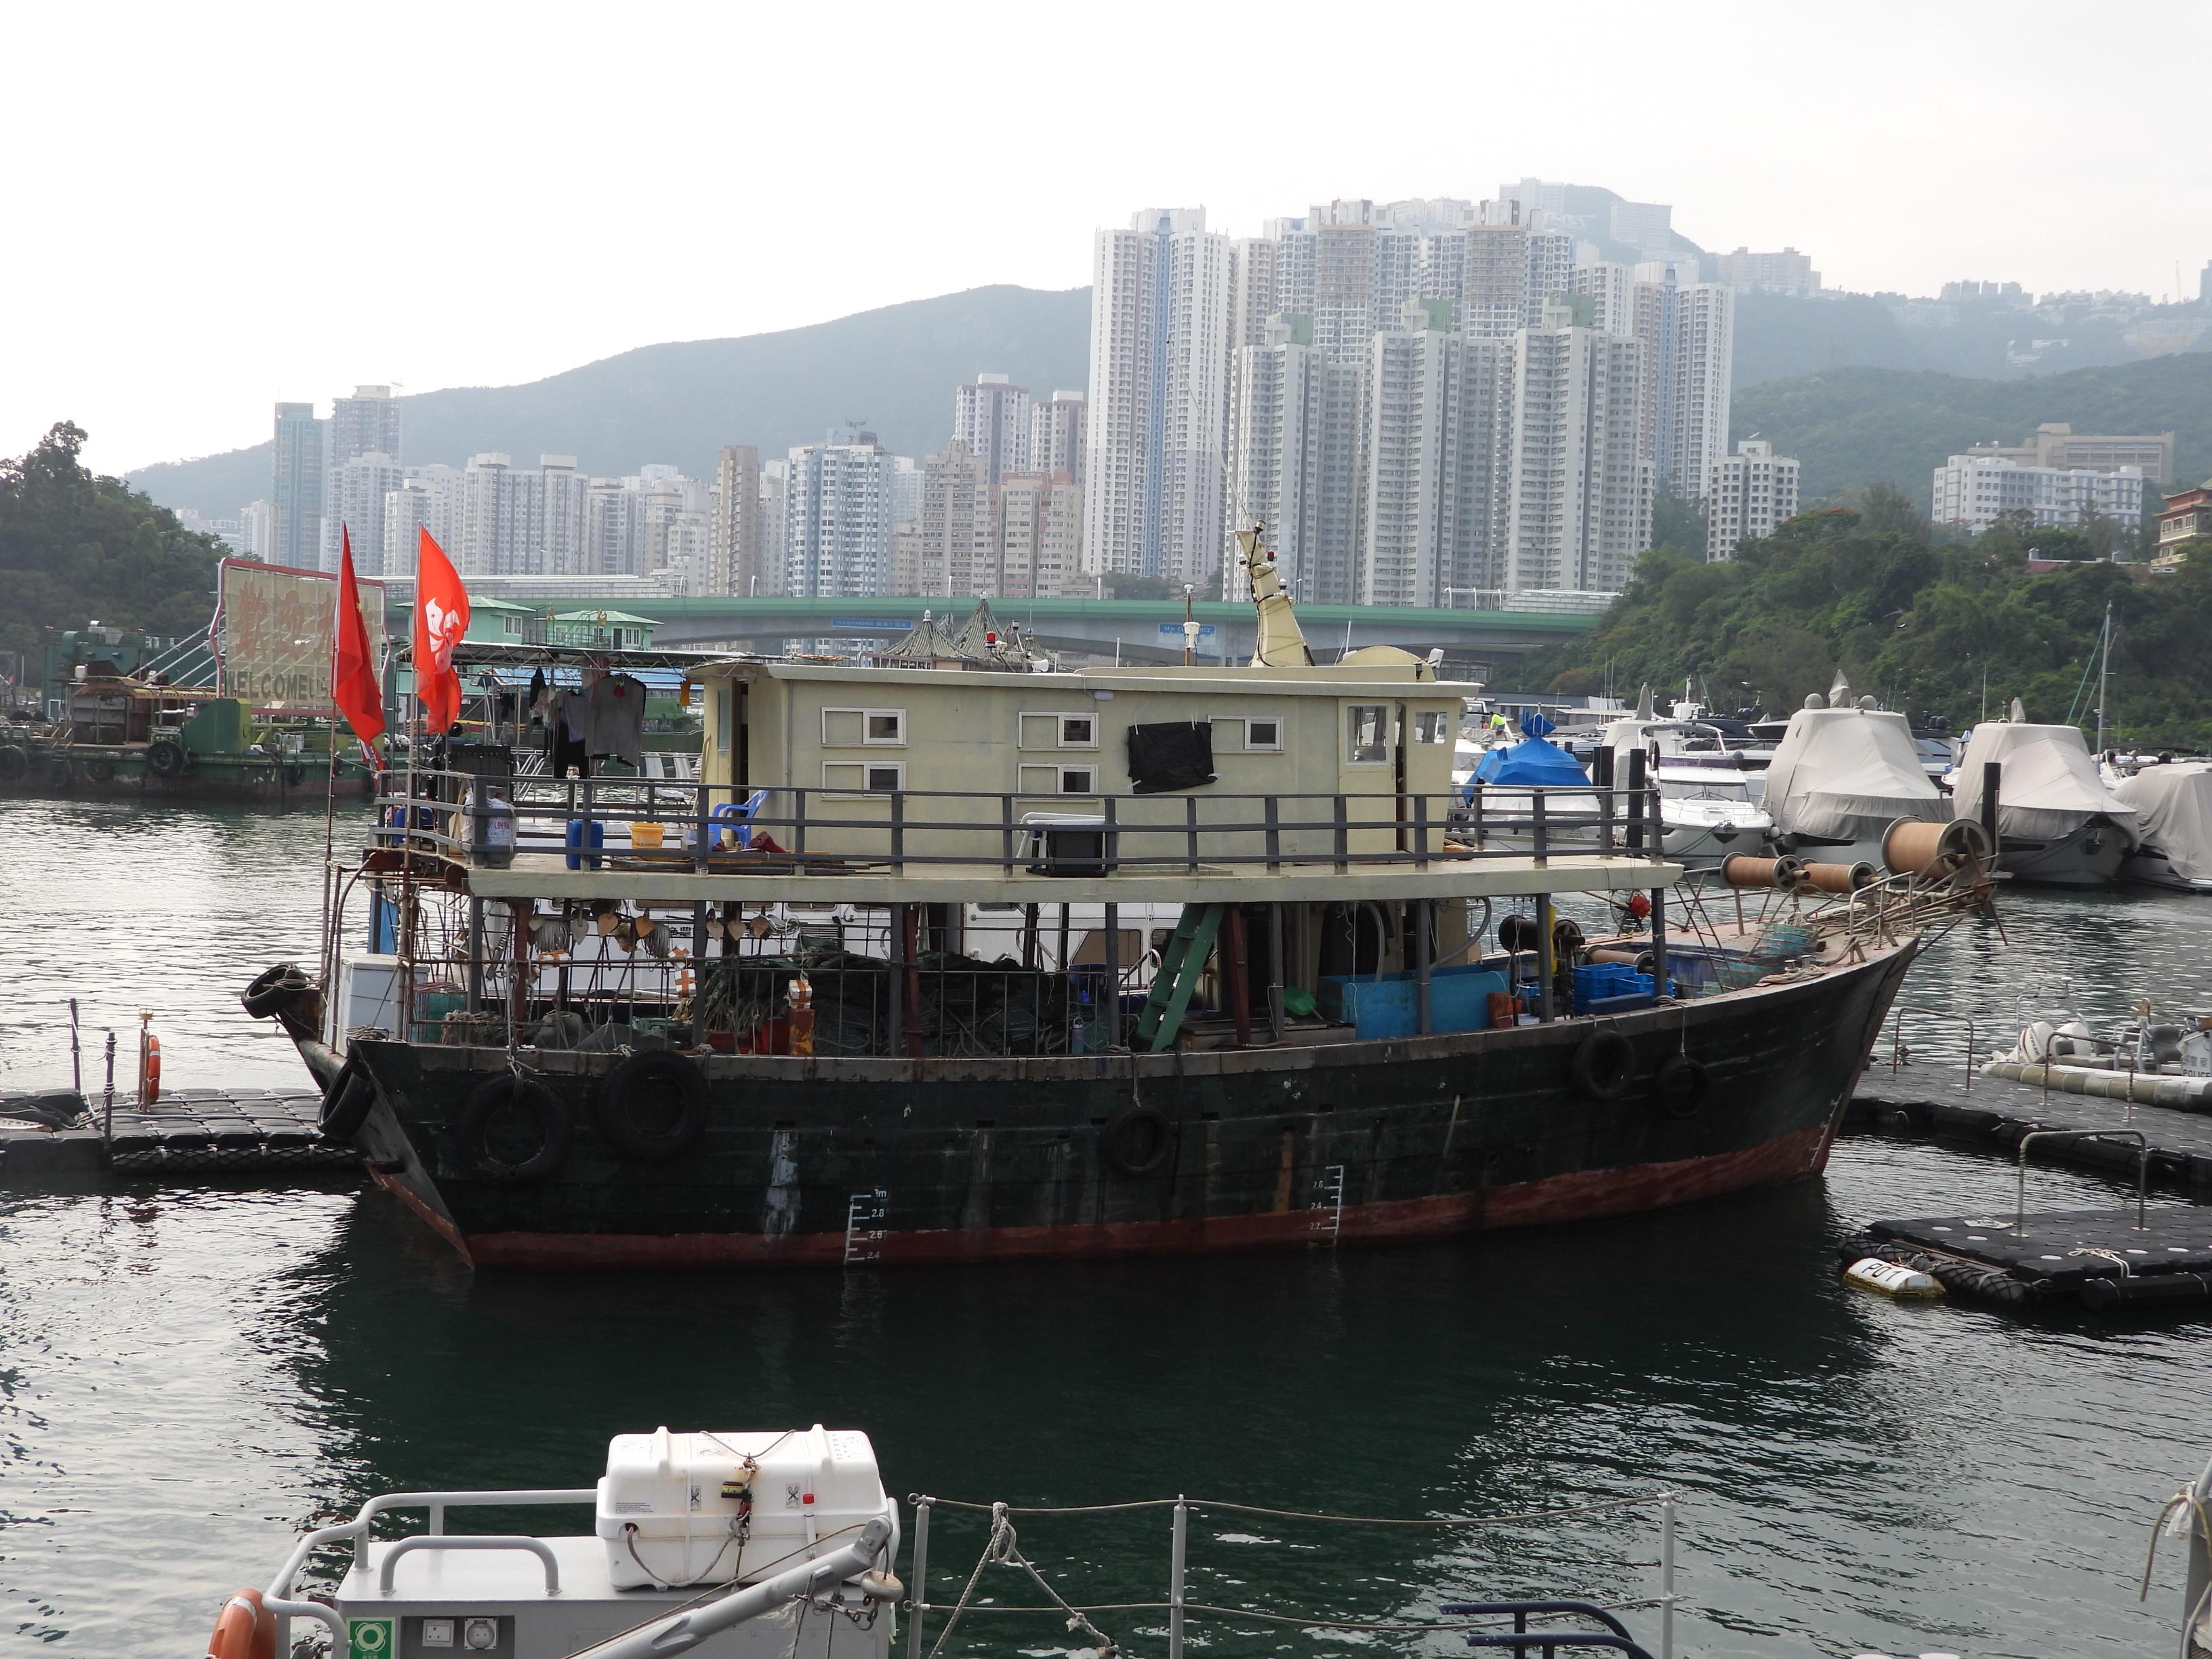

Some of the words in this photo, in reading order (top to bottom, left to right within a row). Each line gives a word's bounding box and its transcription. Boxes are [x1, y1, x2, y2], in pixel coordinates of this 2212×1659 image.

[224, 670, 308, 700] WELCOME
[2183, 1069, 2211, 1078] POLICE
[872, 1208, 884, 1218] 2.8
[869, 1230, 882, 1239] 2.6
